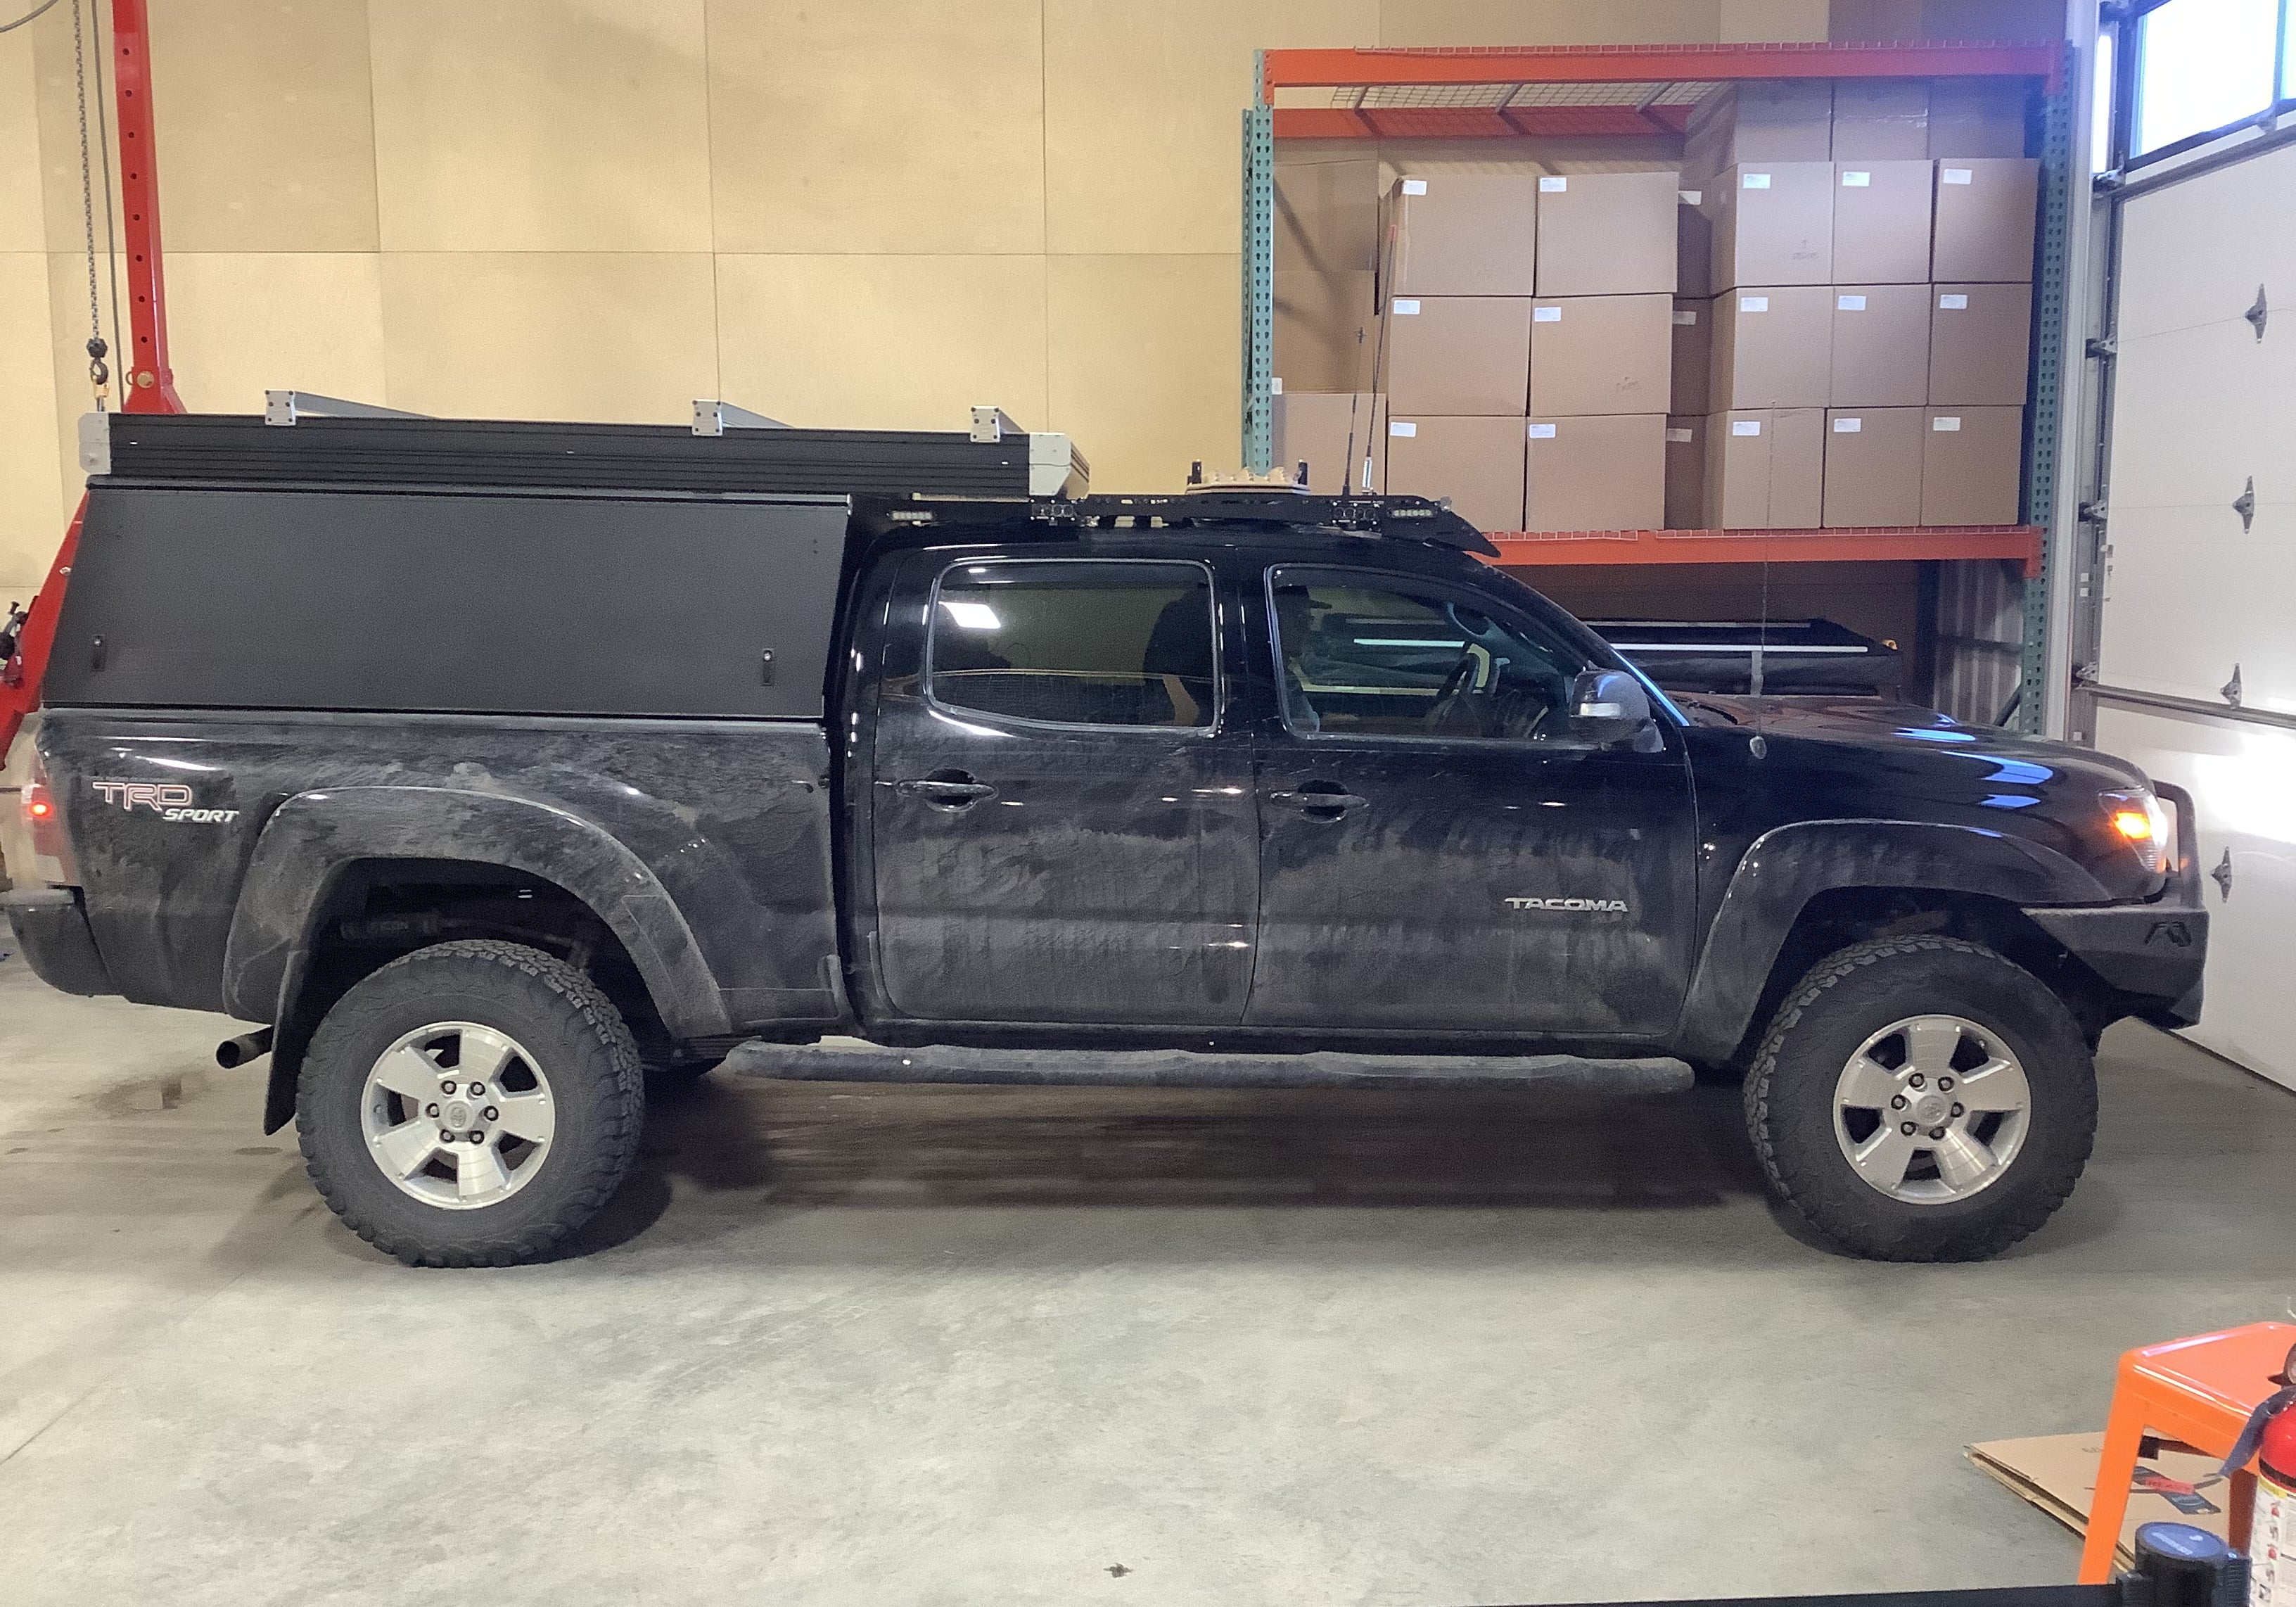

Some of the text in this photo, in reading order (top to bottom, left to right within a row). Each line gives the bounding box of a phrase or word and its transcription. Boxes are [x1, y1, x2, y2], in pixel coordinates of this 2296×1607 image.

[92, 782, 193, 812] TRD
[162, 808, 239, 822] SPORT
[1504, 897, 1628, 913] TACOMA
